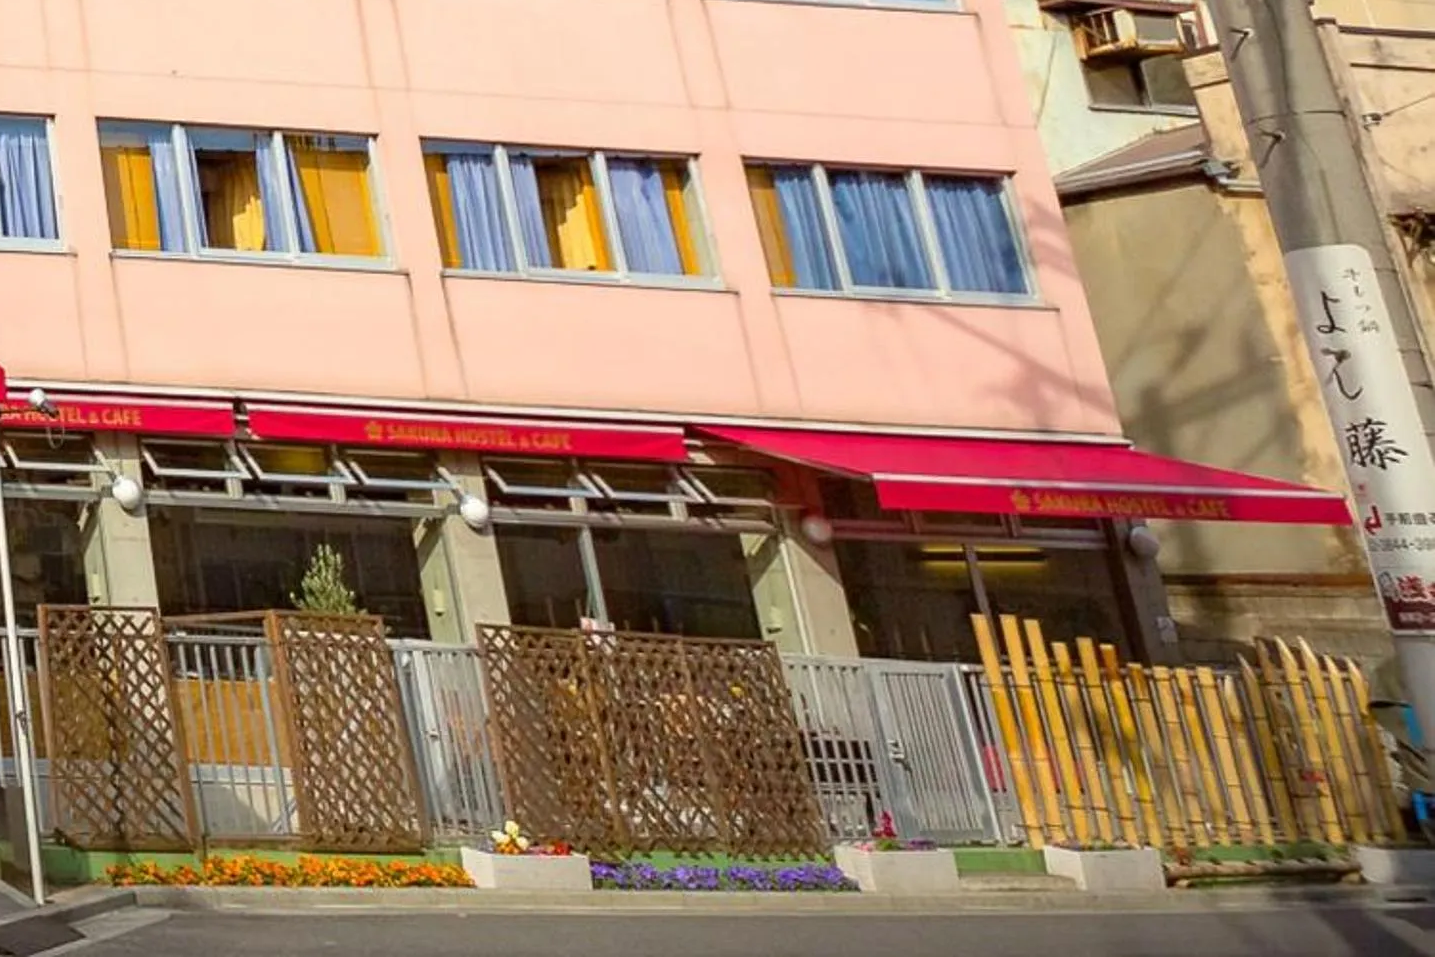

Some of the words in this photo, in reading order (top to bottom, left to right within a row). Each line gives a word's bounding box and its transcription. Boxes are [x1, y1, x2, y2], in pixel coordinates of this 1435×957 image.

[102, 408, 142, 426] CAFE
[388, 425, 454, 444] SAKURA
[455, 428, 517, 448] HOSTEL
[532, 432, 572, 451] CAFE
[1107, 495, 1170, 516] HOSTEL
[1187, 499, 1230, 518] CAFE
